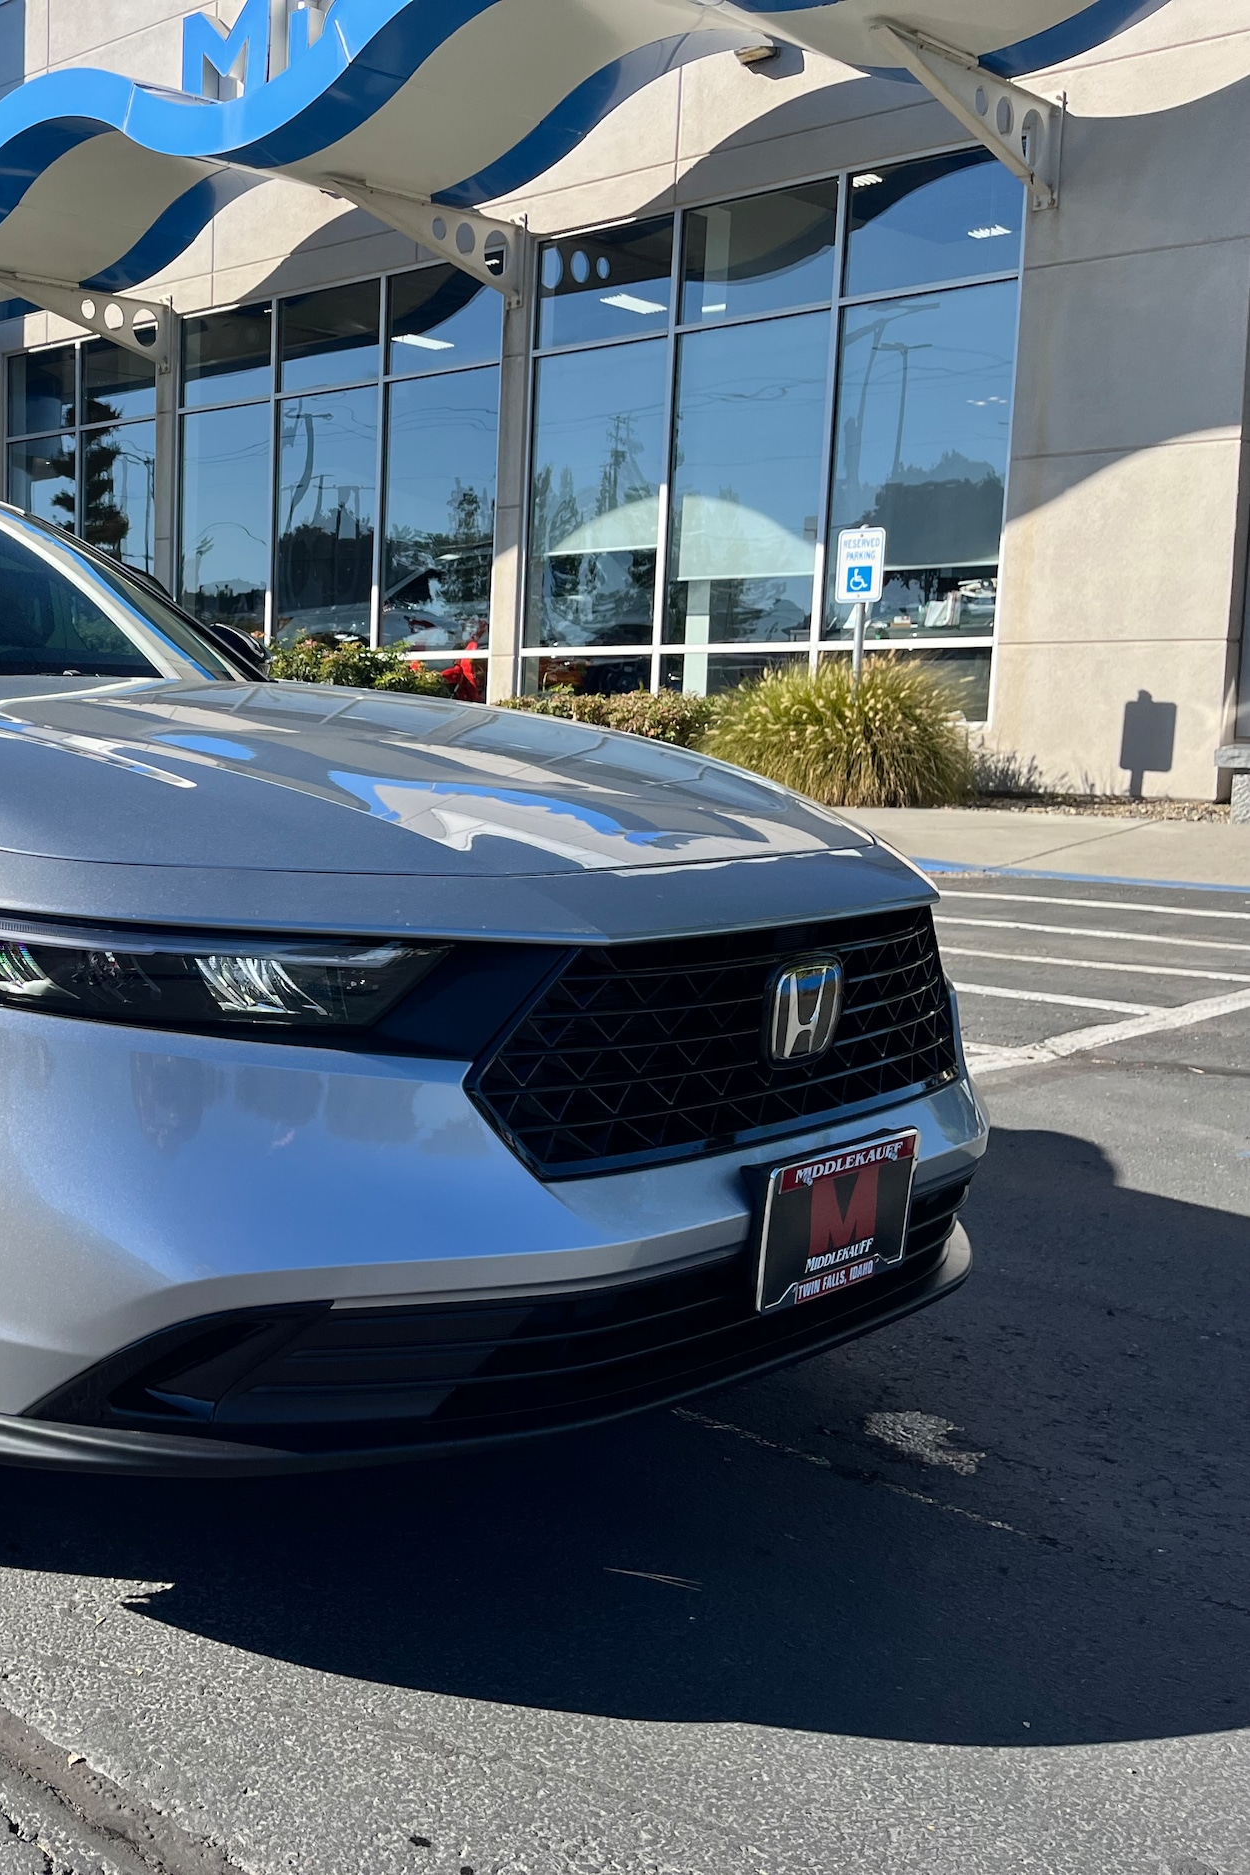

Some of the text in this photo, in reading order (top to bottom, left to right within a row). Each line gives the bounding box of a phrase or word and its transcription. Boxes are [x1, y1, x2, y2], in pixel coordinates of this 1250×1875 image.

[843, 537, 881, 549] RESERVED
[846, 550, 876, 561] PARKING
[795, 1141, 904, 1185] MIDDLEKAUFF
[804, 1237, 874, 1274] MIDDLEKAUFF
[797, 1260, 874, 1300] TWIN FALLS, IDAHO
